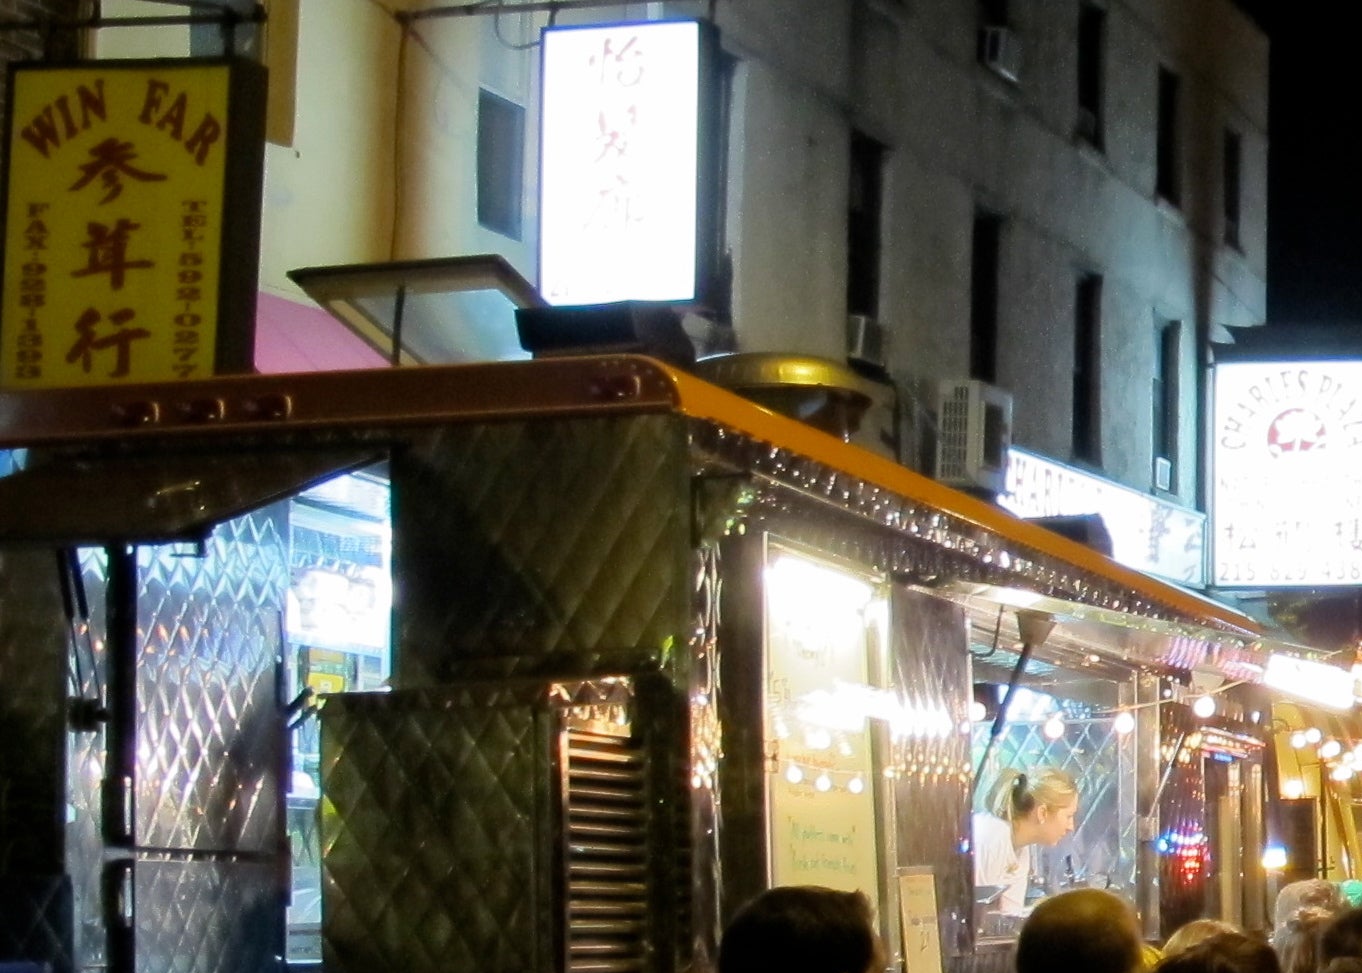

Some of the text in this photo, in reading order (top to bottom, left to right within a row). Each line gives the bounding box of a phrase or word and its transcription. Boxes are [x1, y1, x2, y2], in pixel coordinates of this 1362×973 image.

[21, 79, 222, 167] WIN FAR
[1221, 370, 1309, 449] CHARLES
[1219, 562, 1256, 581] 215
